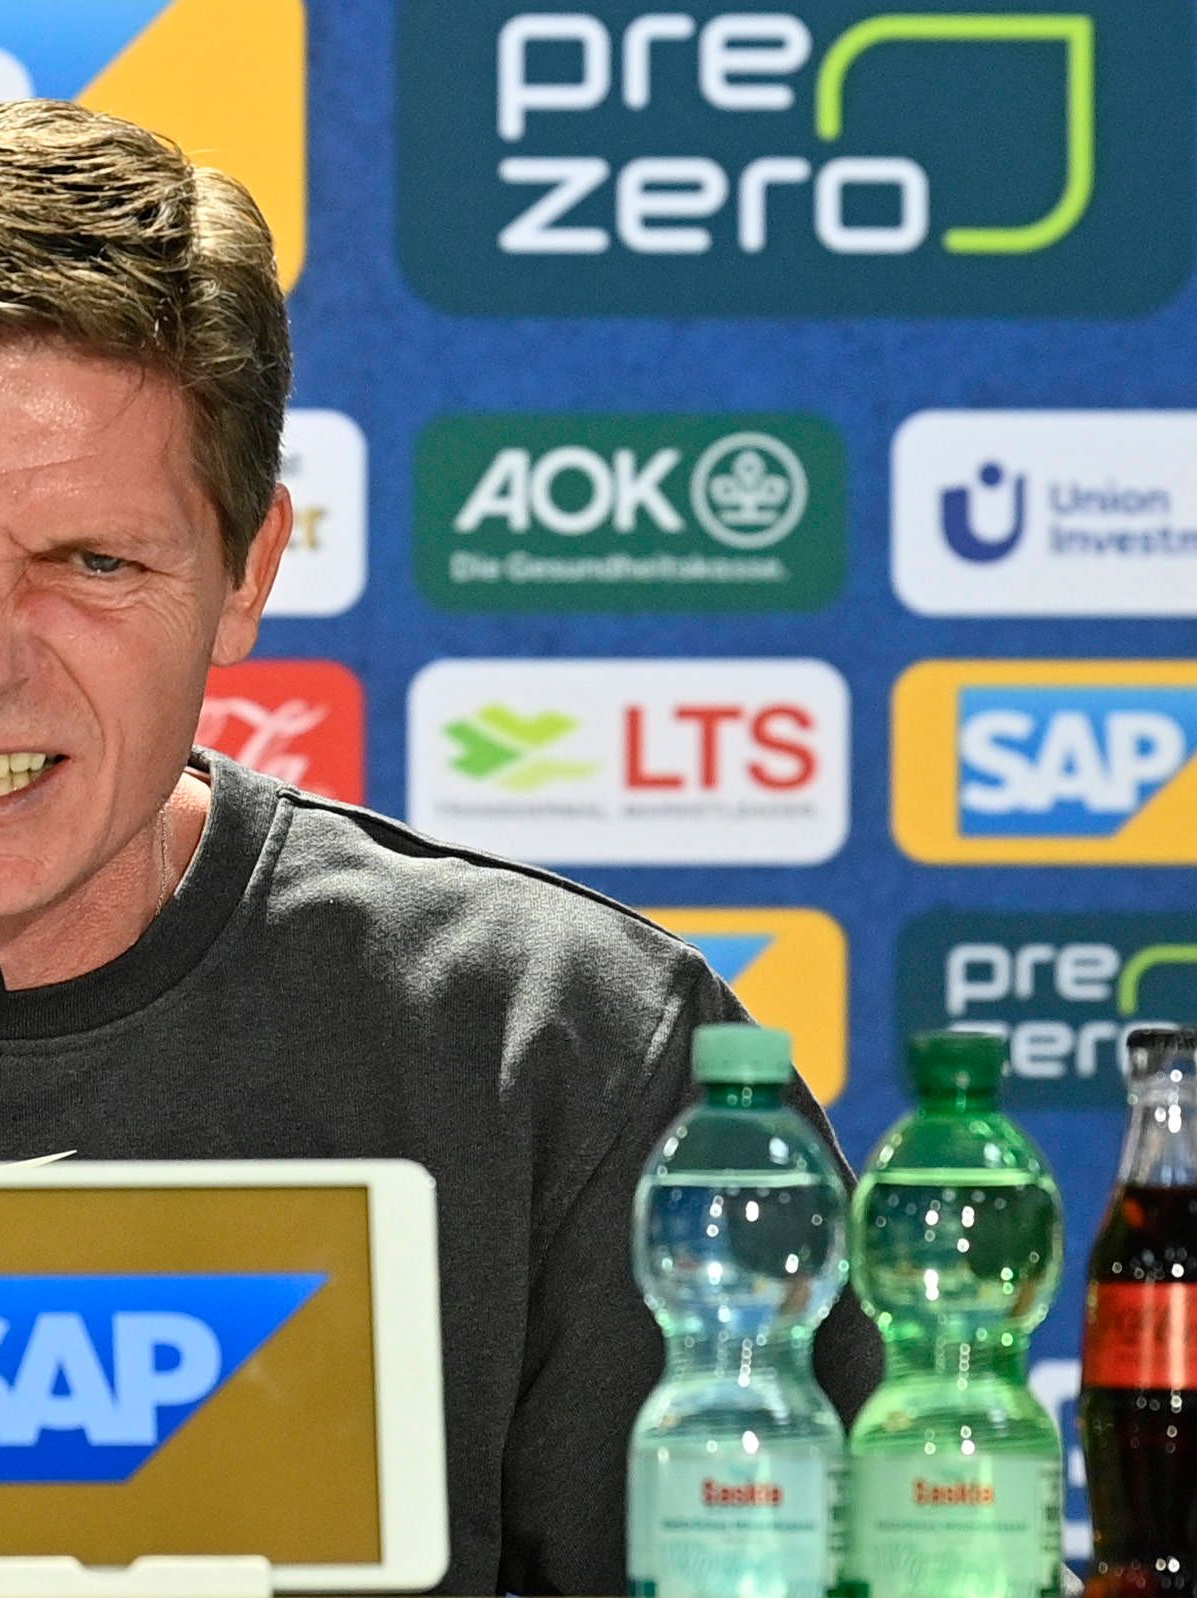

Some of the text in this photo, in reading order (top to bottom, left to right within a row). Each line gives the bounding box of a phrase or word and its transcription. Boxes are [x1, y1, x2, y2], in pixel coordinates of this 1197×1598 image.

[498, 13, 811, 141] pre
[498, 157, 929, 254] zero
[454, 444, 687, 537] AOK
[1049, 475, 1170, 516] Union
[622, 704, 819, 793] LTS
[961, 710, 1184, 814] SAP
[946, 943, 1121, 1017] pre
